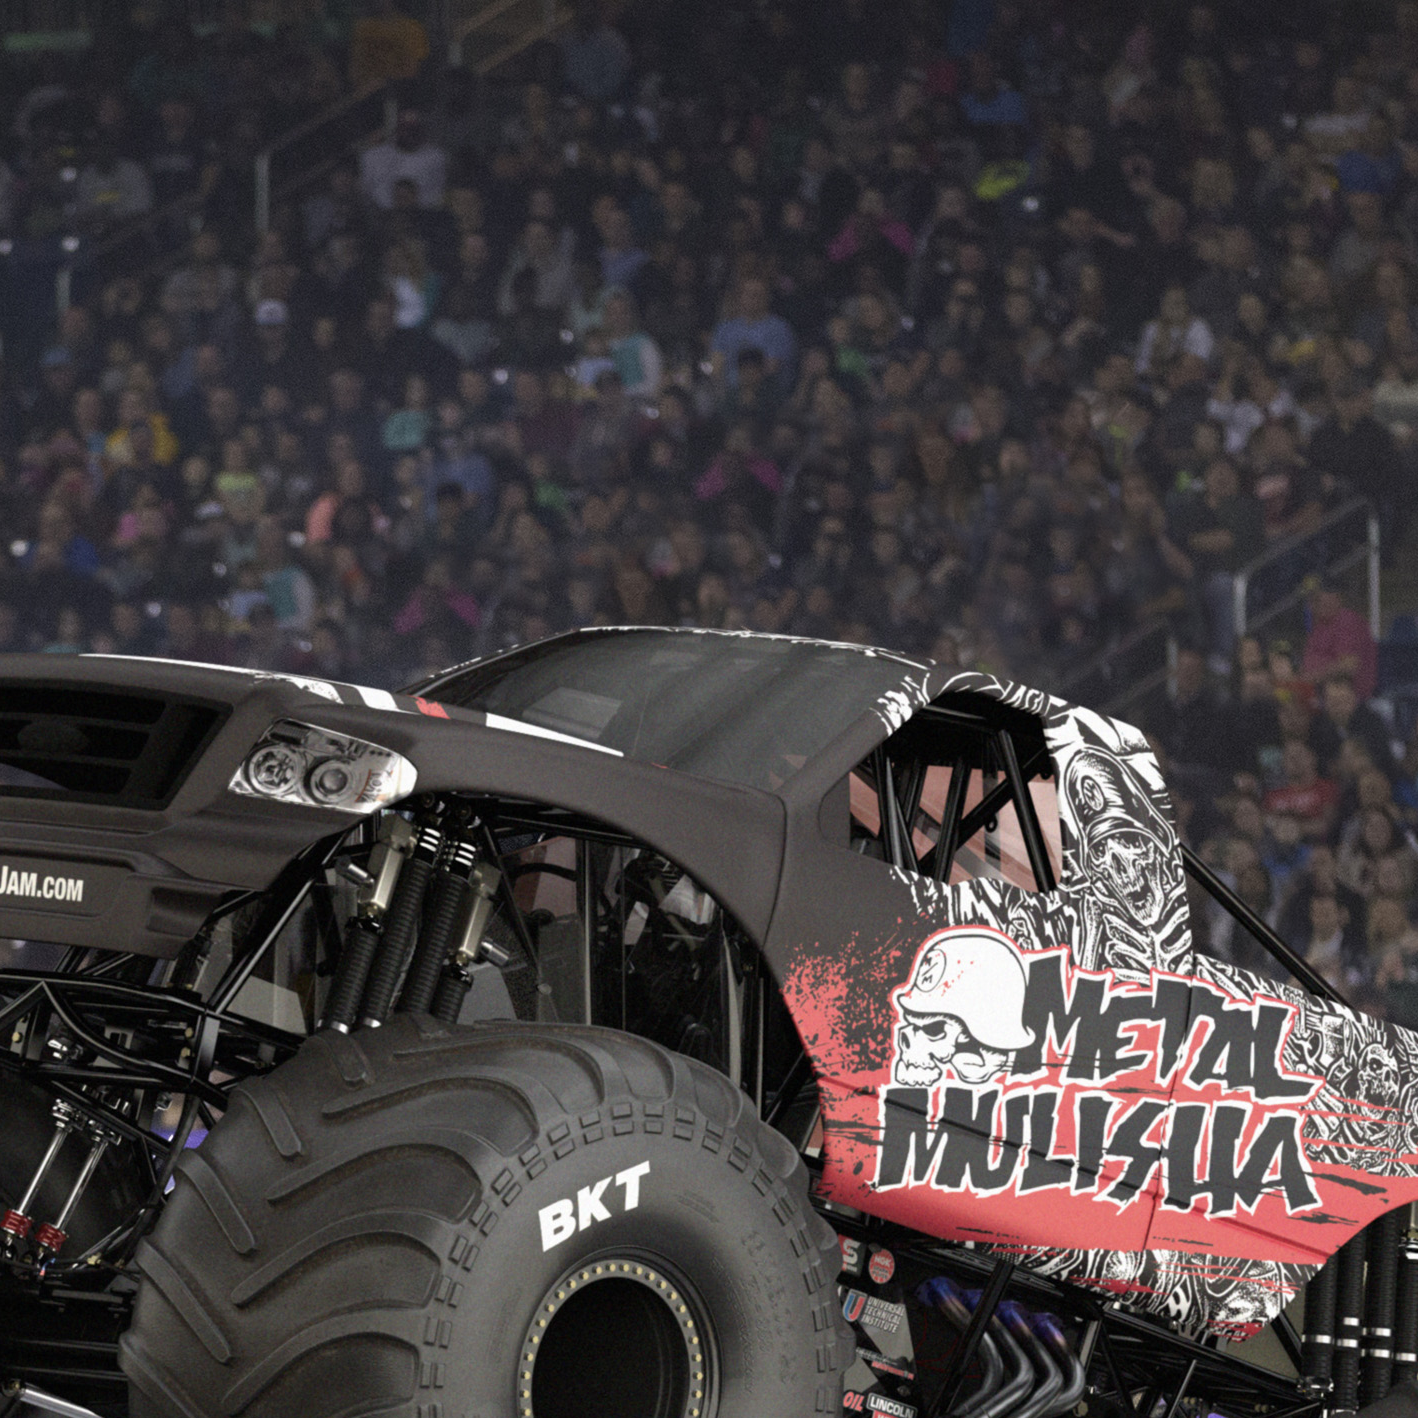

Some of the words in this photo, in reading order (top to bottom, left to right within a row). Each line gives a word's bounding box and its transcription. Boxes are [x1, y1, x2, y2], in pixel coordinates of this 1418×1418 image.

[1008, 948, 1323, 1104] METAL
[874, 1084, 1322, 1219] MULISHA
[538, 1160, 651, 1252] BKT
[864, 1305, 902, 1325] TECHNICAL
[867, 1296, 906, 1317] UNIVERSAL
[861, 1314, 899, 1333] INSTITUTE
[842, 1391, 865, 1412] OIL
